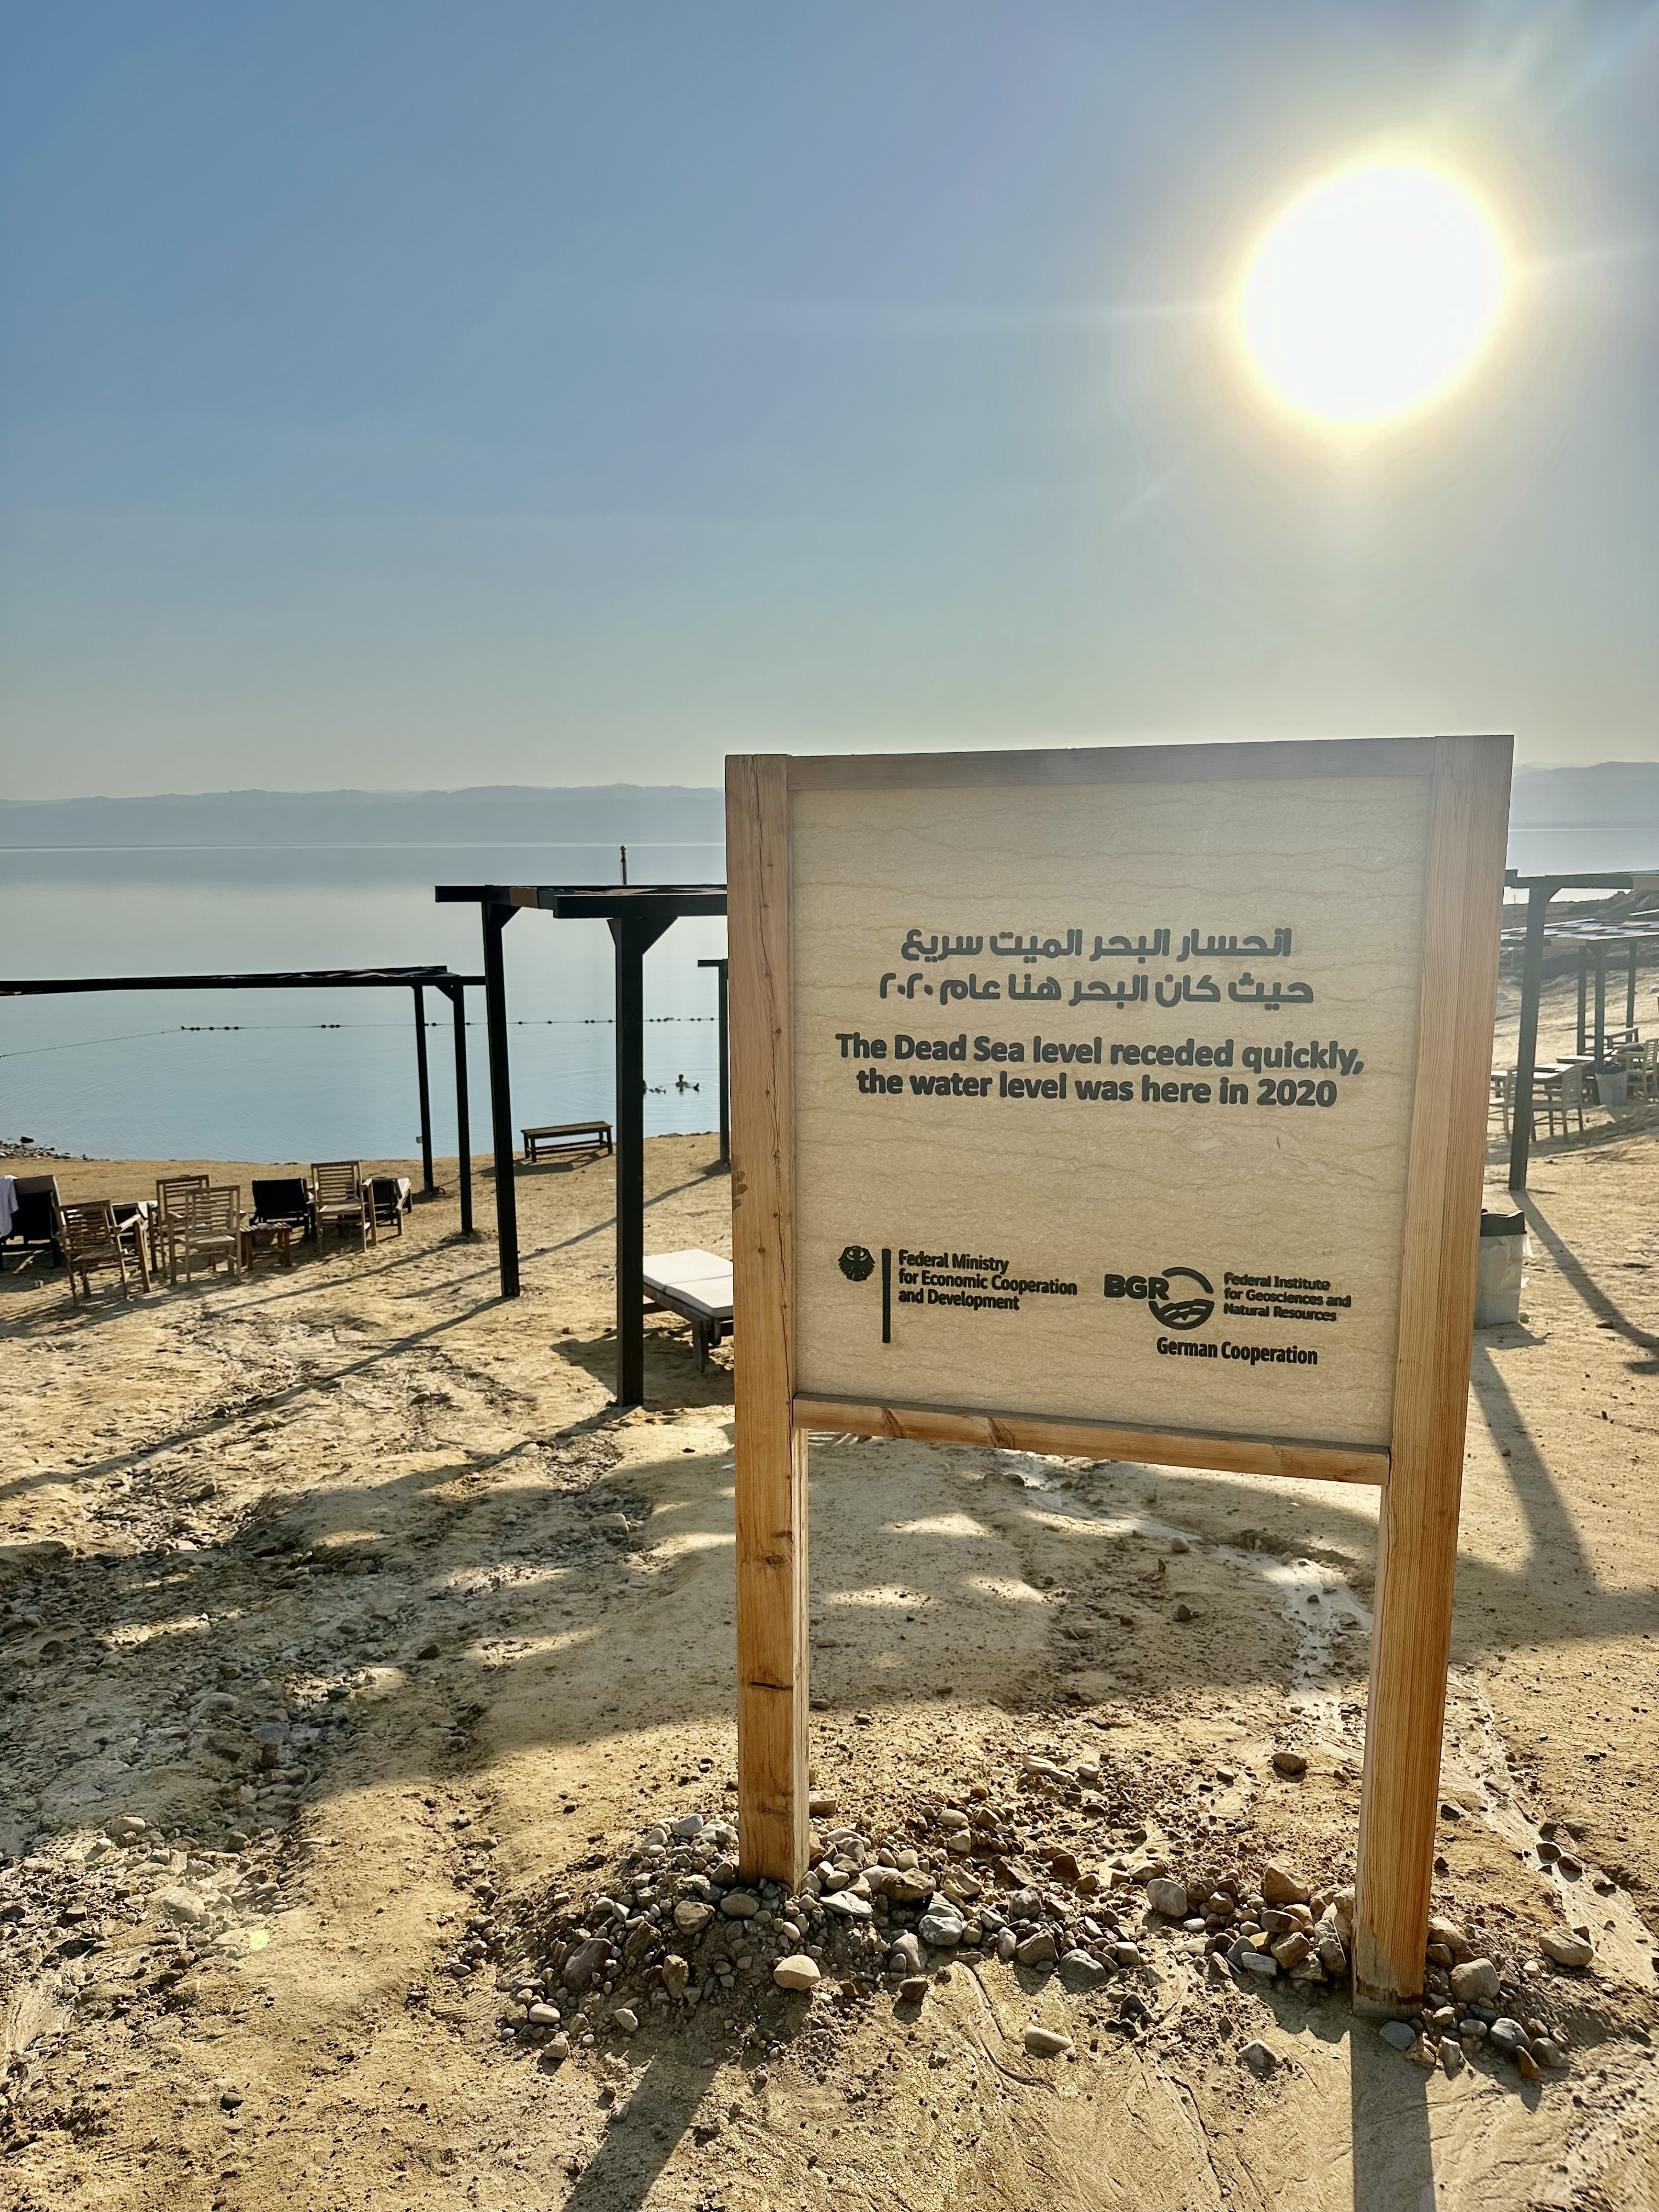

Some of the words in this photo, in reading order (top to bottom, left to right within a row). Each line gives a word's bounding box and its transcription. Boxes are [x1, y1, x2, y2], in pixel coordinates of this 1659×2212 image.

[901, 929, 983, 963] سريع
[990, 929, 1082, 963] الميت
[1090, 929, 1170, 963] البحر
[1177, 928, 1291, 962] انحسار
[880, 973, 933, 999] ٢٠٢٠
[940, 974, 1000, 1005] عام
[1008, 974, 1062, 1000] هنا
[1069, 974, 1148, 1009] البحر
[1155, 974, 1221, 1007] كان
[1228, 973, 1313, 1011] حيث
[835, 1032, 887, 1059] The
[895, 1034, 967, 1060] Dead
[973, 1036, 1024, 1062] Sea
[1034, 1036, 1102, 1064] level
[1110, 1039, 1234, 1067] receded
[1242, 1041, 1364, 1076] quickly,
[856, 1068, 903, 1094] the
[909, 1073, 992, 1097] water
[1000, 1071, 1066, 1099] level
[1075, 1080, 1133, 1101] was
[1142, 1075, 1211, 1104] here
[1220, 1077, 1248, 1104] in
[1257, 1079, 1337, 1107] 2020
[899, 1249, 949, 1268] Federal
[952, 1253, 1009, 1274] Ministry
[899, 1268, 919, 1284] for
[922, 1270, 988, 1289] Economic
[991, 1274, 1077, 1296] Cooperation
[1104, 1274, 1169, 1300] BGR
[1224, 1272, 1271, 1287] Federal
[1274, 1276, 1331, 1291] Institute
[898, 1288, 924, 1304] and
[928, 1289, 1020, 1311] Development
[1224, 1287, 1244, 1300] for
[1246, 1289, 1324, 1306] Geosciences
[1325, 1295, 1351, 1308] and
[1223, 1303, 1269, 1317] Natural
[1273, 1306, 1337, 1322] Resources
[1156, 1337, 1218, 1358] German
[1221, 1341, 1318, 1365] Cooperation
